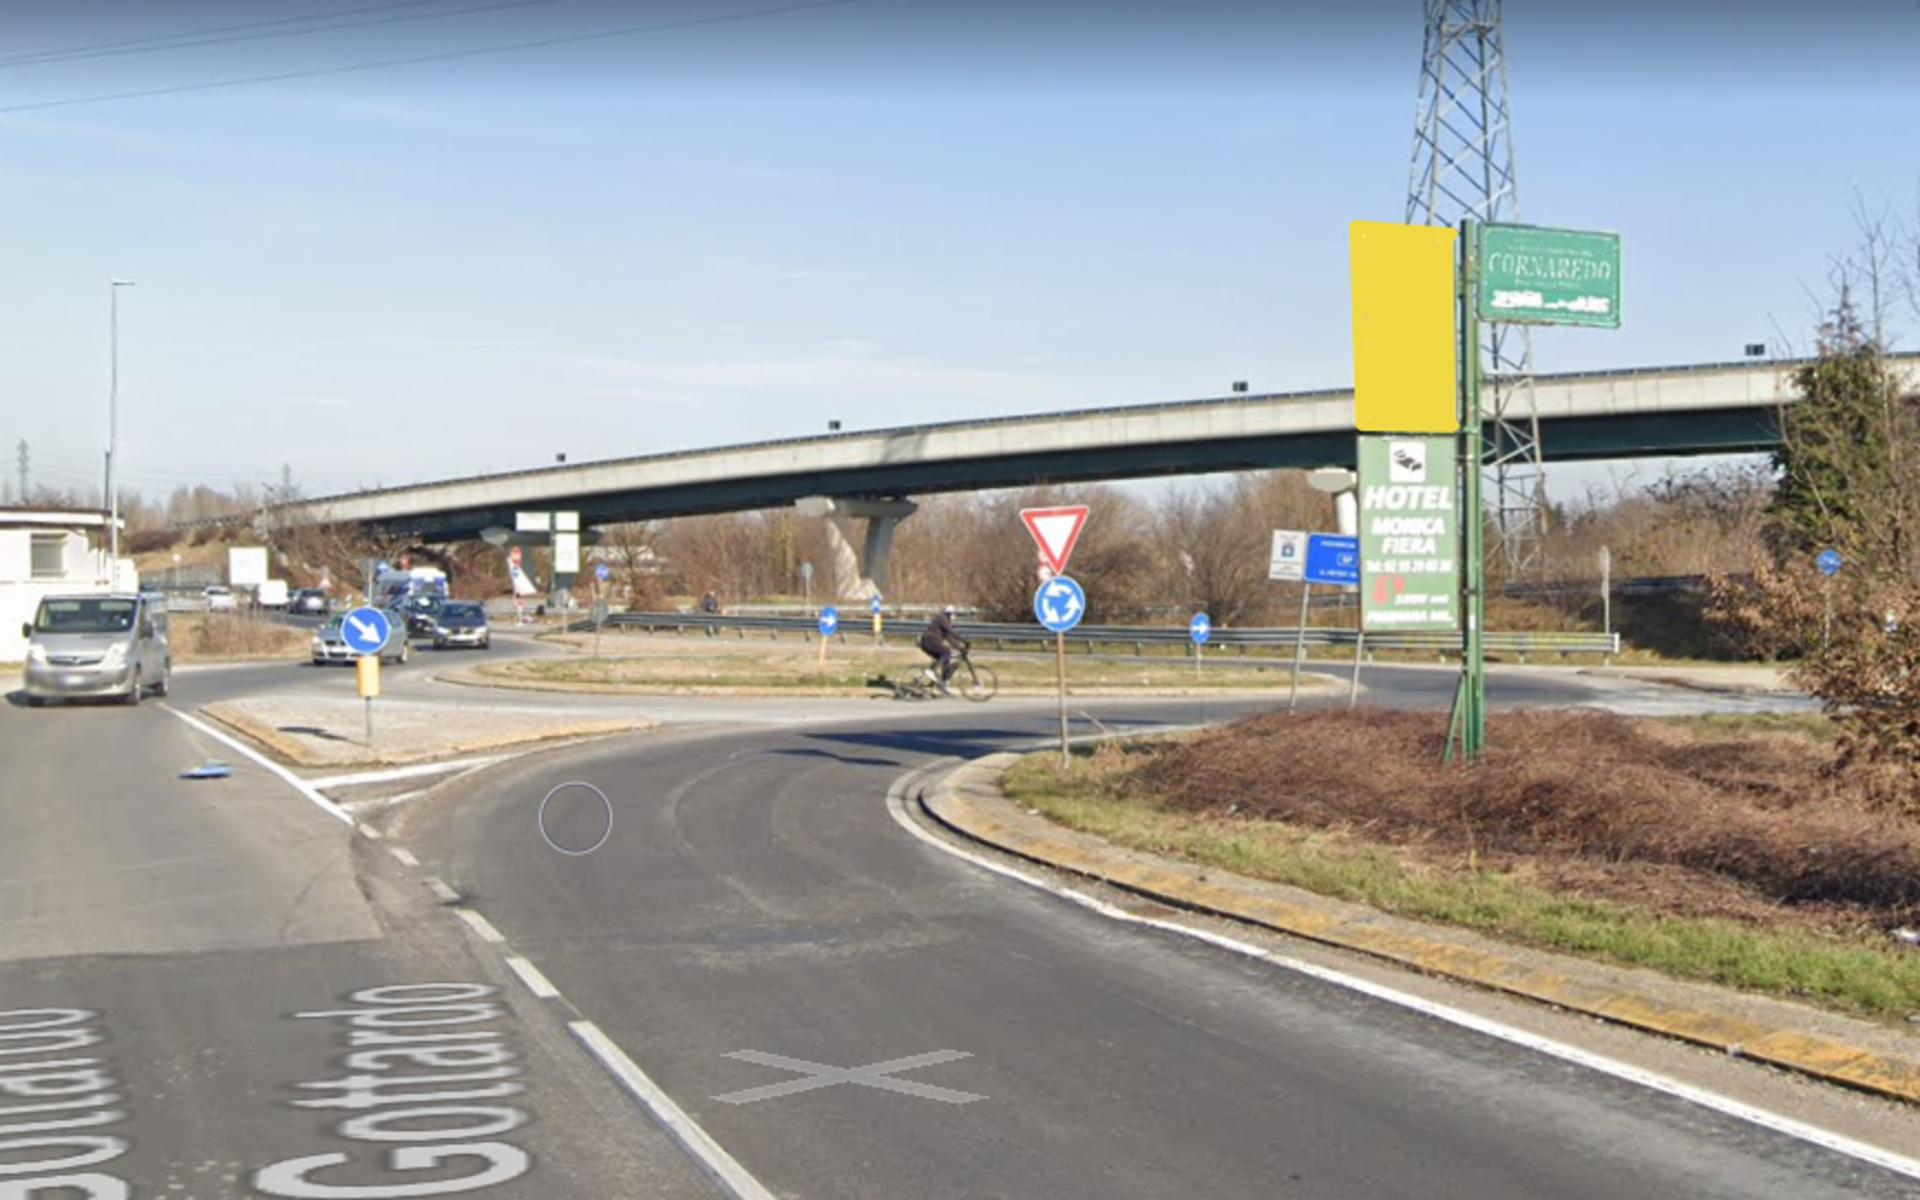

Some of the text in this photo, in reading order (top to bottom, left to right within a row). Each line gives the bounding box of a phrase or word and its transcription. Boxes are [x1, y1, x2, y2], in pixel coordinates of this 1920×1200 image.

[1488, 252, 1611, 280] CORNAREDO
[1365, 486, 1452, 509] HOTEL
[1371, 517, 1445, 536] MONICA
[1382, 537, 1437, 555] FIERA
